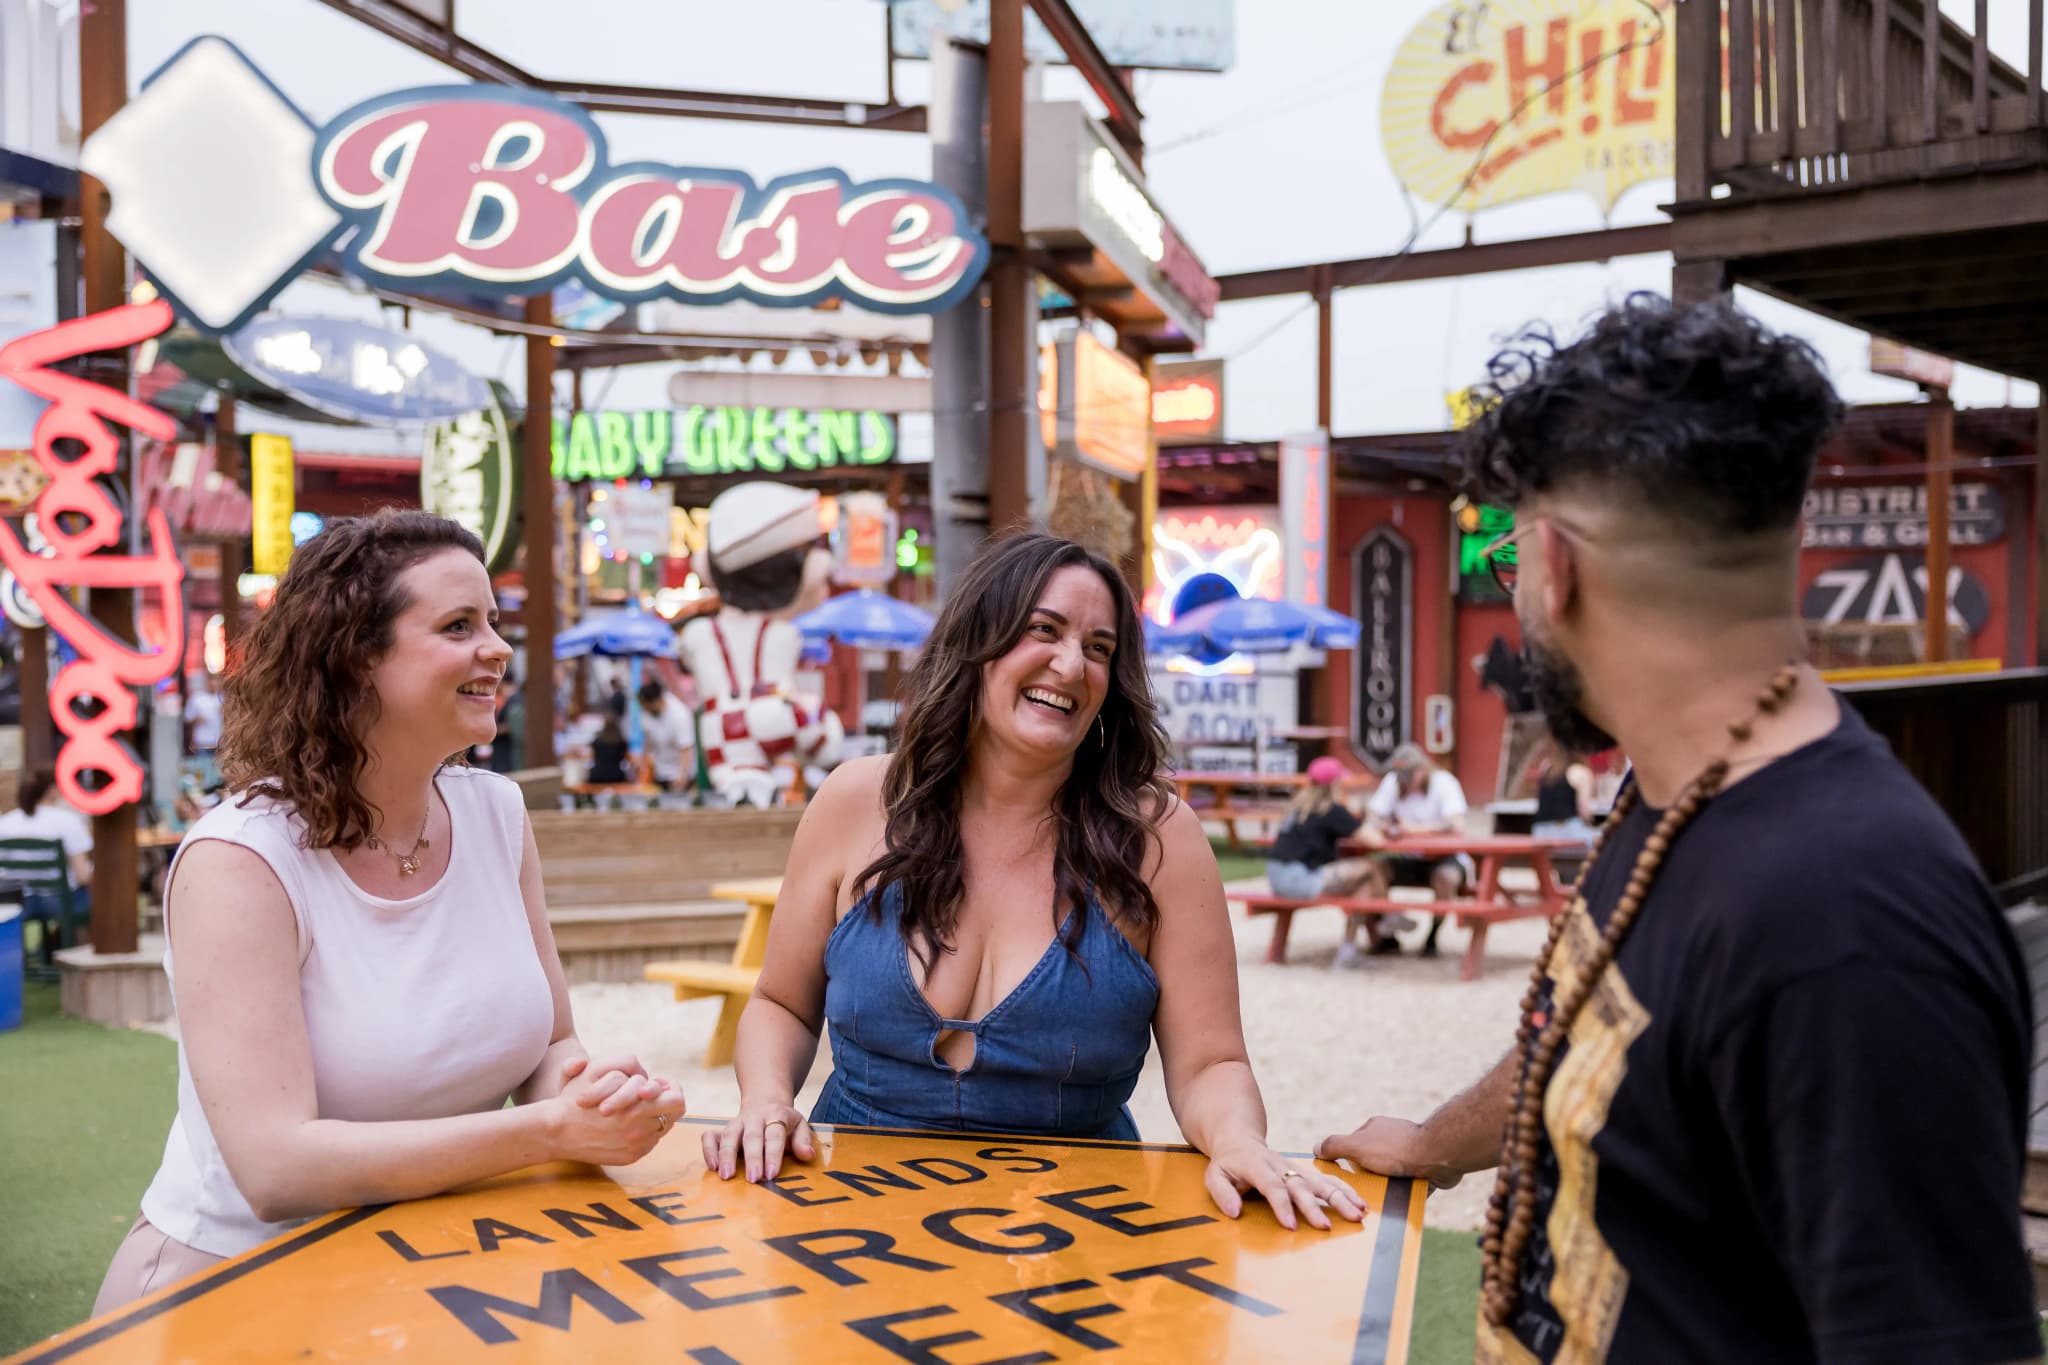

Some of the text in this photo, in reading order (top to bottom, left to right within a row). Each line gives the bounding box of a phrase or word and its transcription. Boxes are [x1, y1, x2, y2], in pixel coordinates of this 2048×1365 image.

[318, 100, 975, 302] Base
[1894, 520, 1984, 546] GLL
[376, 1147, 1059, 1262] LANE ENDS
[426, 1184, 1219, 1345] MERGE
[685, 1256, 1286, 1365] EFT
